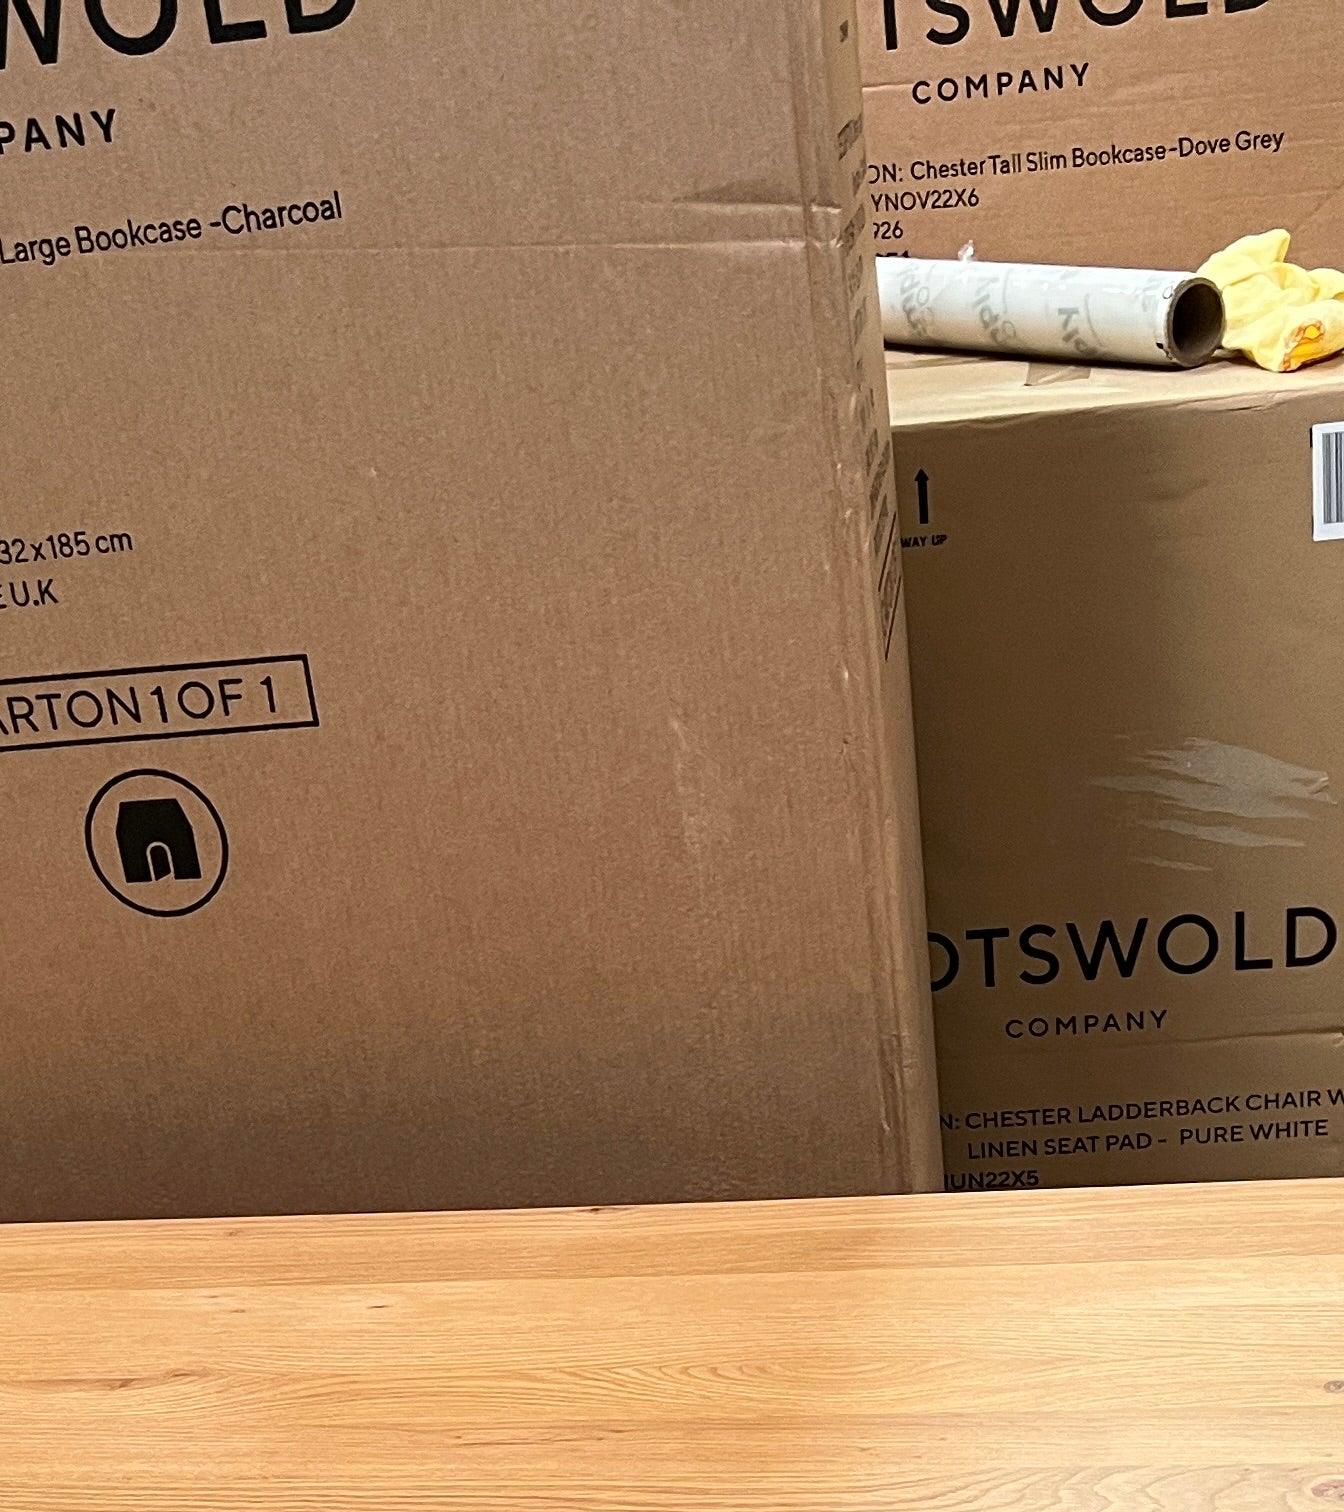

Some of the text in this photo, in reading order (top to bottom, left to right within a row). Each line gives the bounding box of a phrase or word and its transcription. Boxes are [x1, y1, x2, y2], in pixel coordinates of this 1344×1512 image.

[912, 62, 1089, 104] COMPANY
[911, 159, 986, 180] Chester
[987, 153, 1021, 175] Tall
[1026, 151, 1067, 171] Slim
[1235, 131, 1284, 153] Grey
[75, 219, 202, 253] Bookcase
[932, 534, 948, 546] UP
[9, 579, 59, 607] U.K
[1006, 1010, 1167, 1038] COMPANY
[965, 1108, 1071, 1129] CHESTER
[1079, 1096, 1240, 1123] LADDERBACK
[1246, 1090, 1321, 1110] CHAIR
[968, 1140, 1037, 1159] LINEN
[1044, 1136, 1100, 1155] SEAT
[1106, 1133, 1152, 1152] PAD
[1180, 1126, 1244, 1145] PURE
[1249, 1119, 1328, 1140] WHITE
